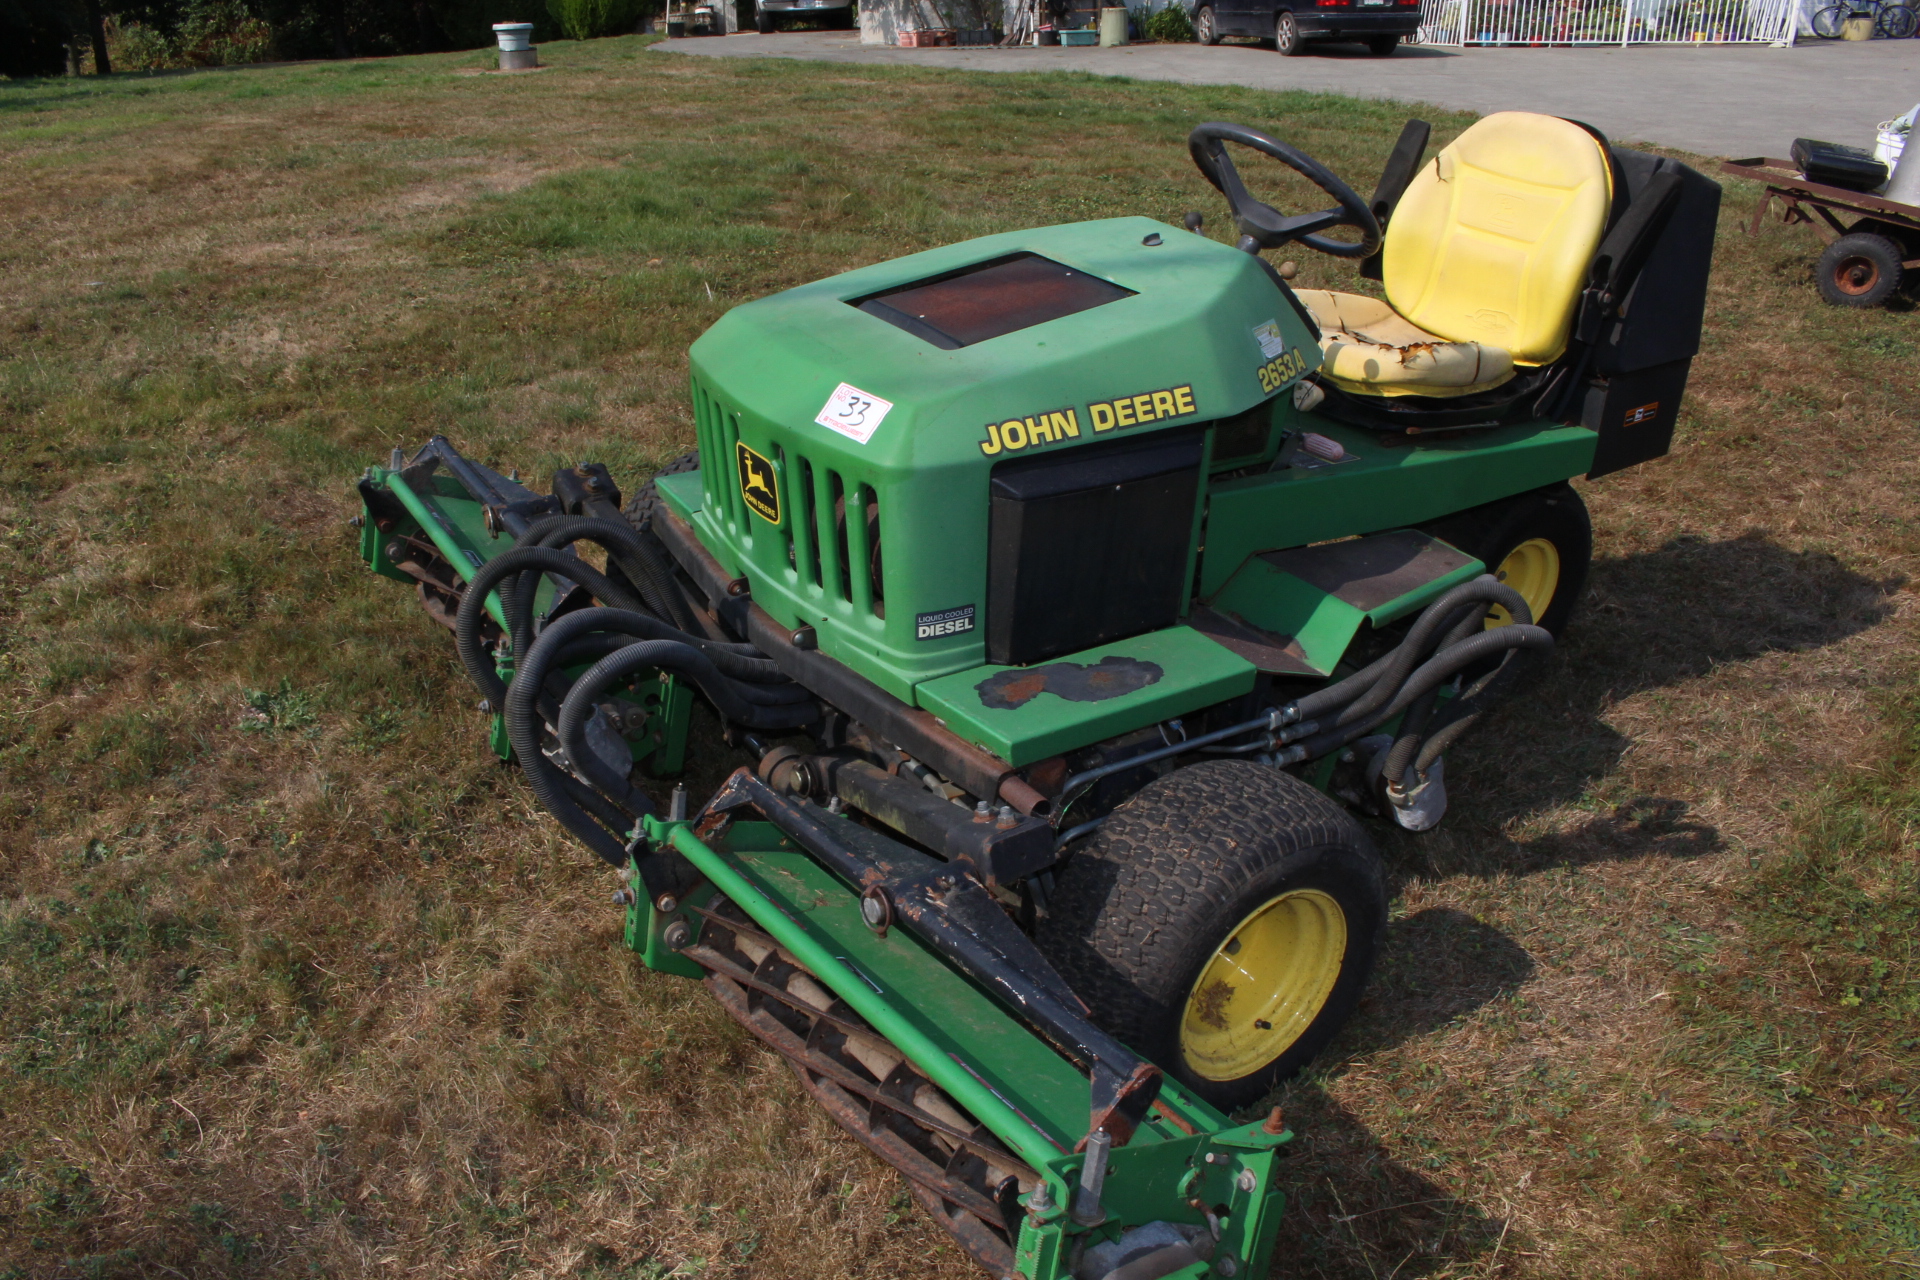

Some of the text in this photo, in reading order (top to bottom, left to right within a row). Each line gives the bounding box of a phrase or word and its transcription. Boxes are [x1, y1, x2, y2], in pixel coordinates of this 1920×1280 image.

[839, 387, 854, 398] LOT
[838, 396, 872, 427] 33
[979, 384, 1197, 456] JOHN DEERE
[744, 491, 777, 519] JOHN DEERE
[918, 607, 974, 623] LIQUID COOLED
[918, 618, 974, 638] DIESEL
